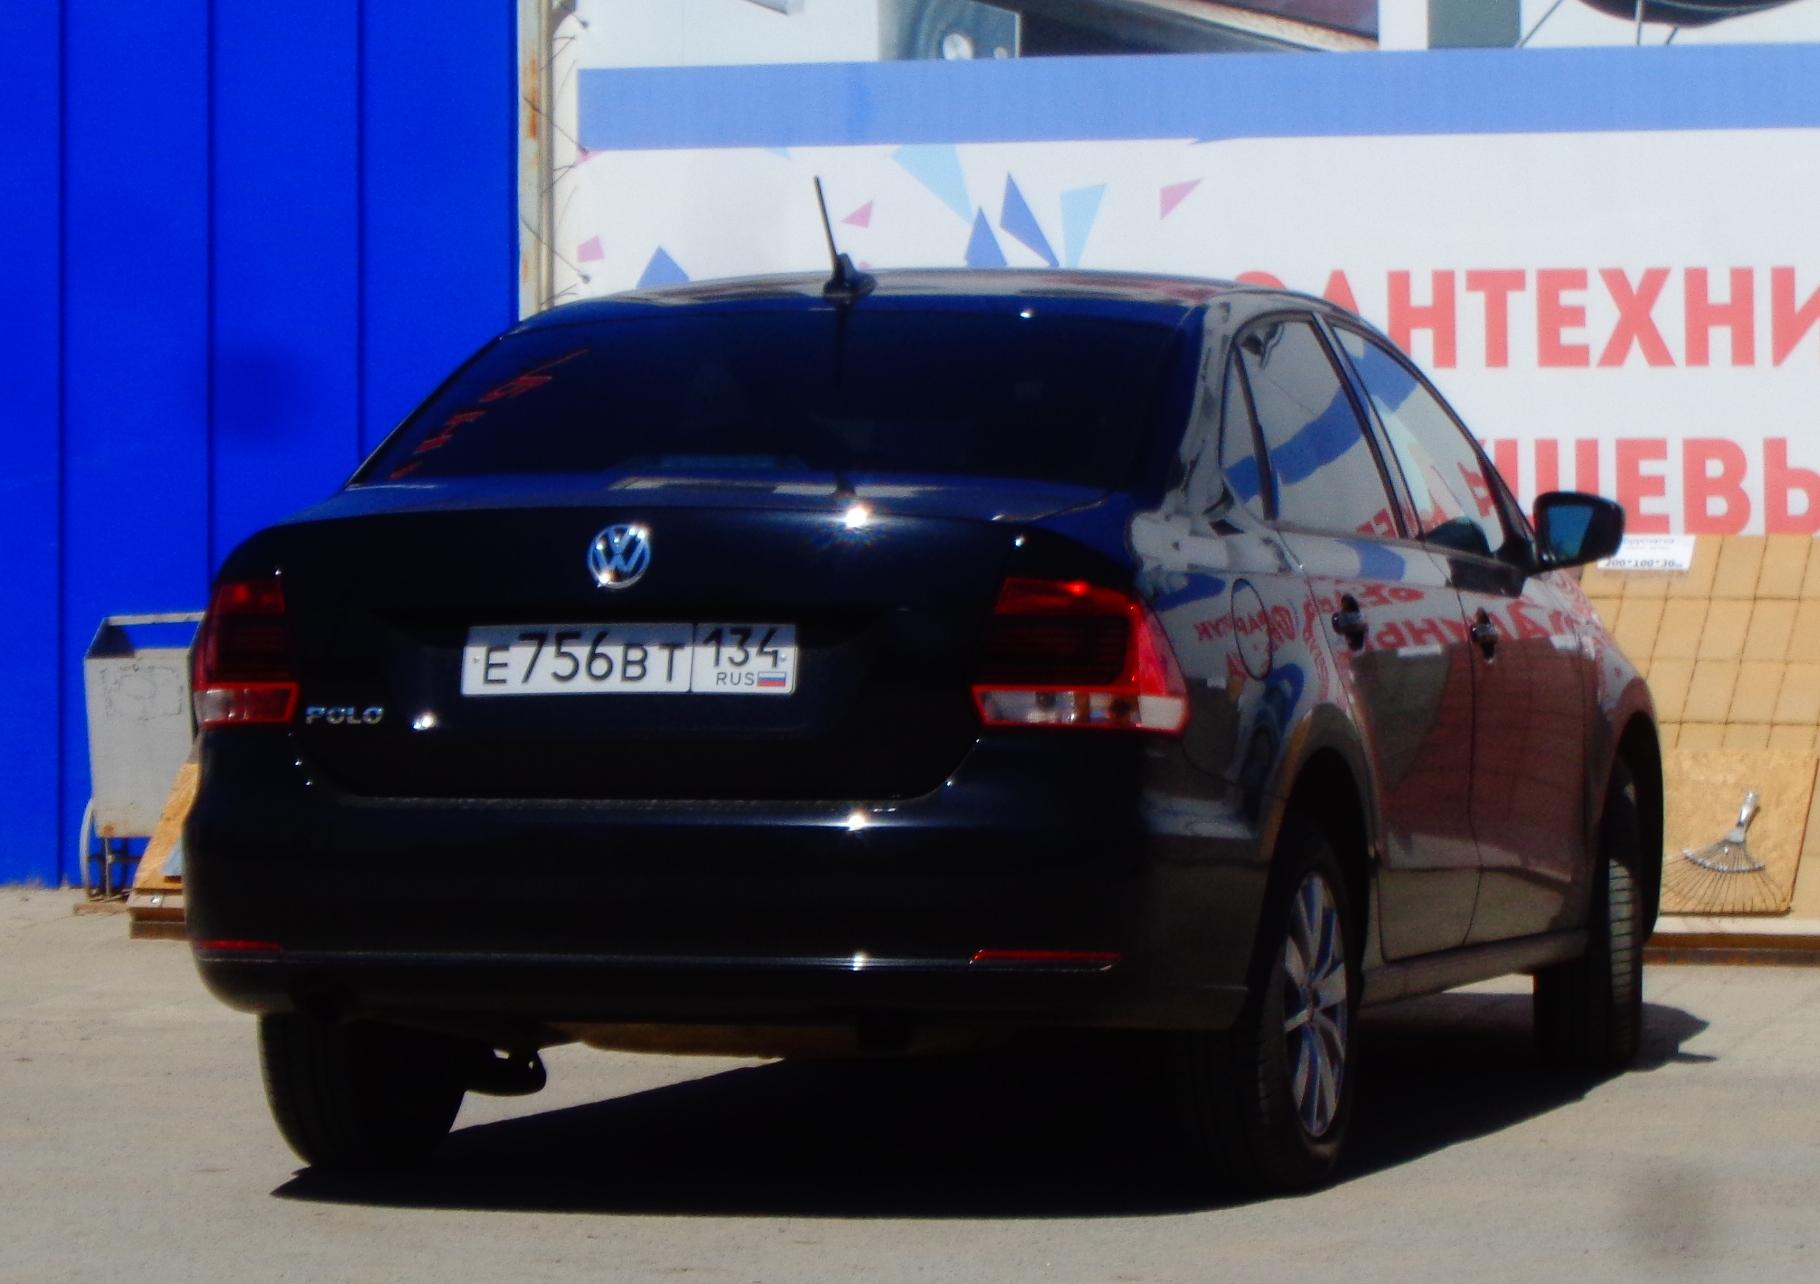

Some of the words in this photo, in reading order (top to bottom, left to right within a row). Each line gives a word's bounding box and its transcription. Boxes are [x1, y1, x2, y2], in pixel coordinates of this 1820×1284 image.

[1234, 266, 1820, 367] НТЕХНИ
[483, 630, 686, 684] Е756ВТ
[703, 628, 779, 668] 134
[716, 672, 755, 686] RUS
[305, 706, 385, 725] POLO
